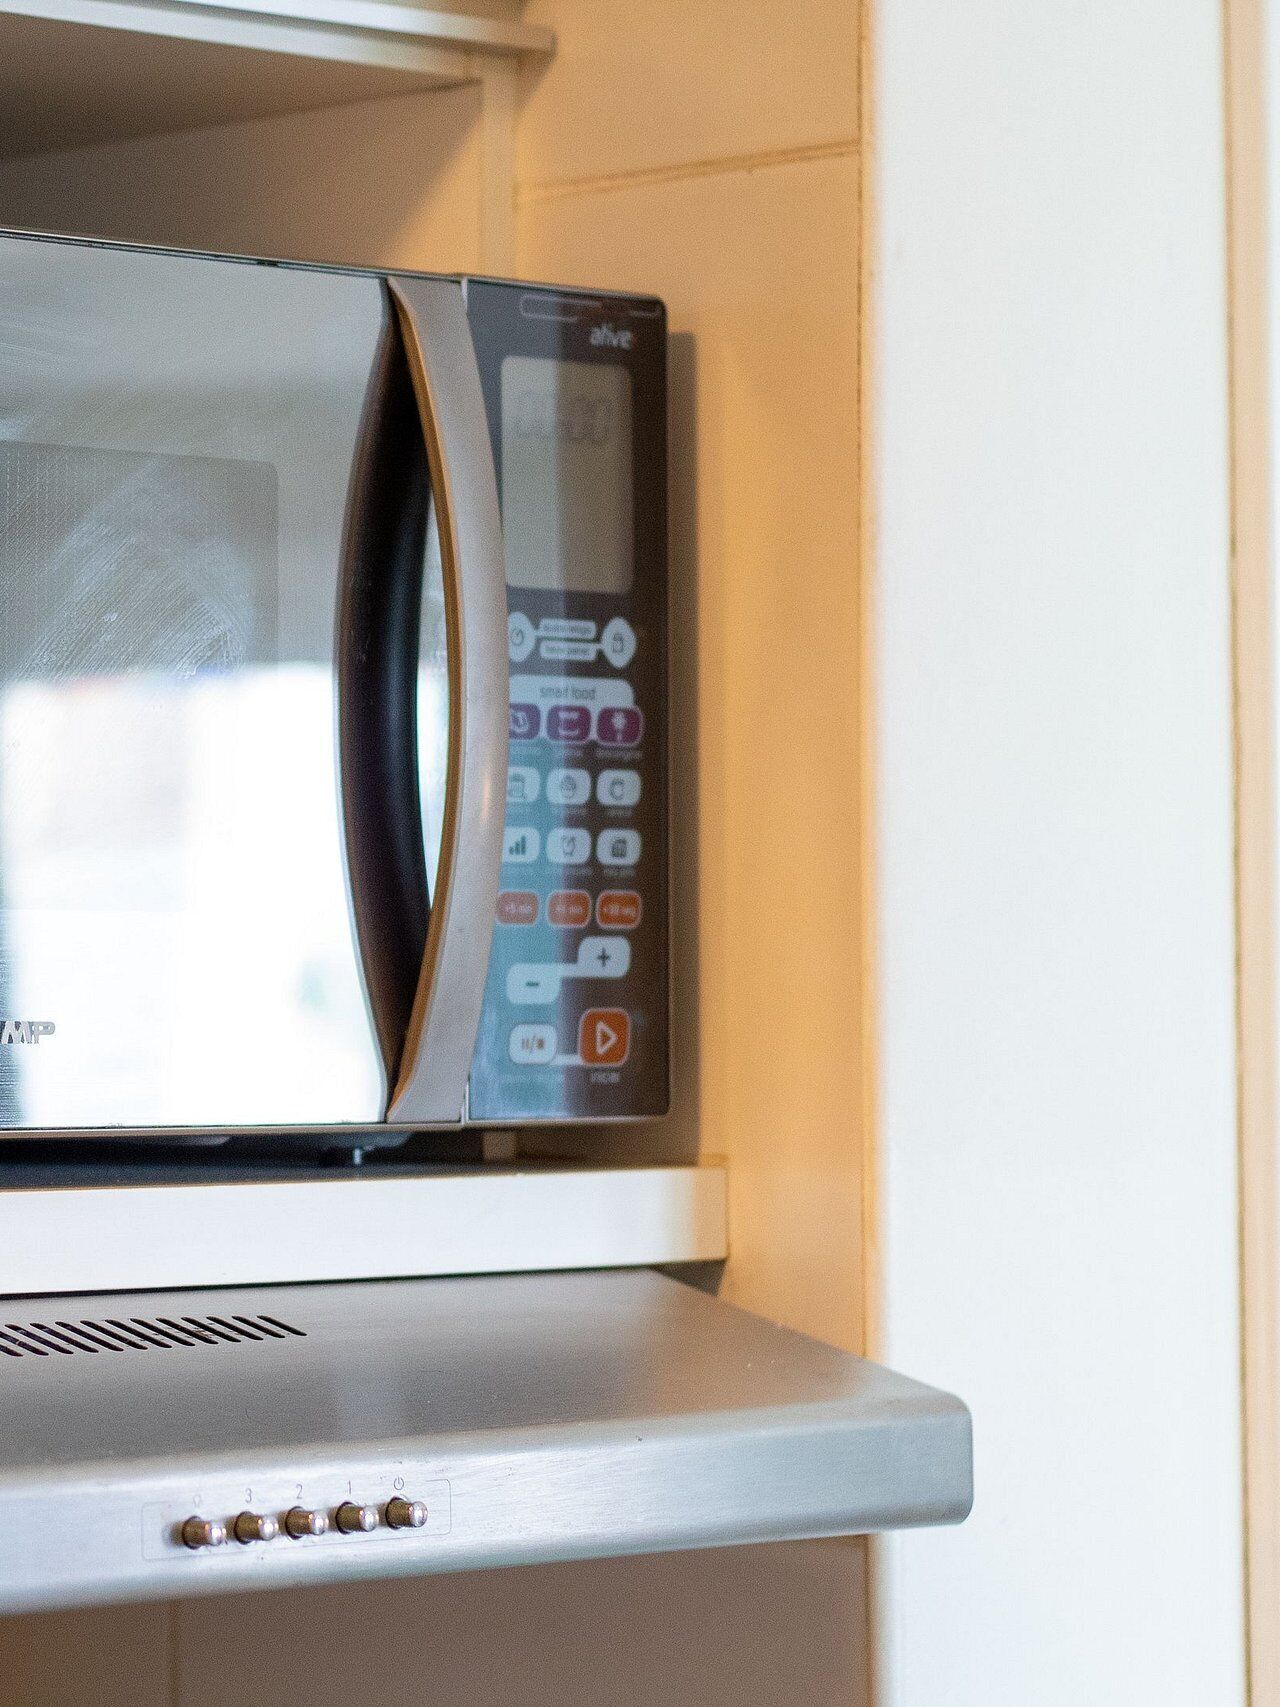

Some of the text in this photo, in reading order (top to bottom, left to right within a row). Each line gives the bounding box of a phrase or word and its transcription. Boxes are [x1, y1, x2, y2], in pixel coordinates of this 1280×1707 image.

[244, 1487, 252, 1503] 3
[296, 1484, 303, 1500] 2
[347, 1480, 352, 1495] 1
